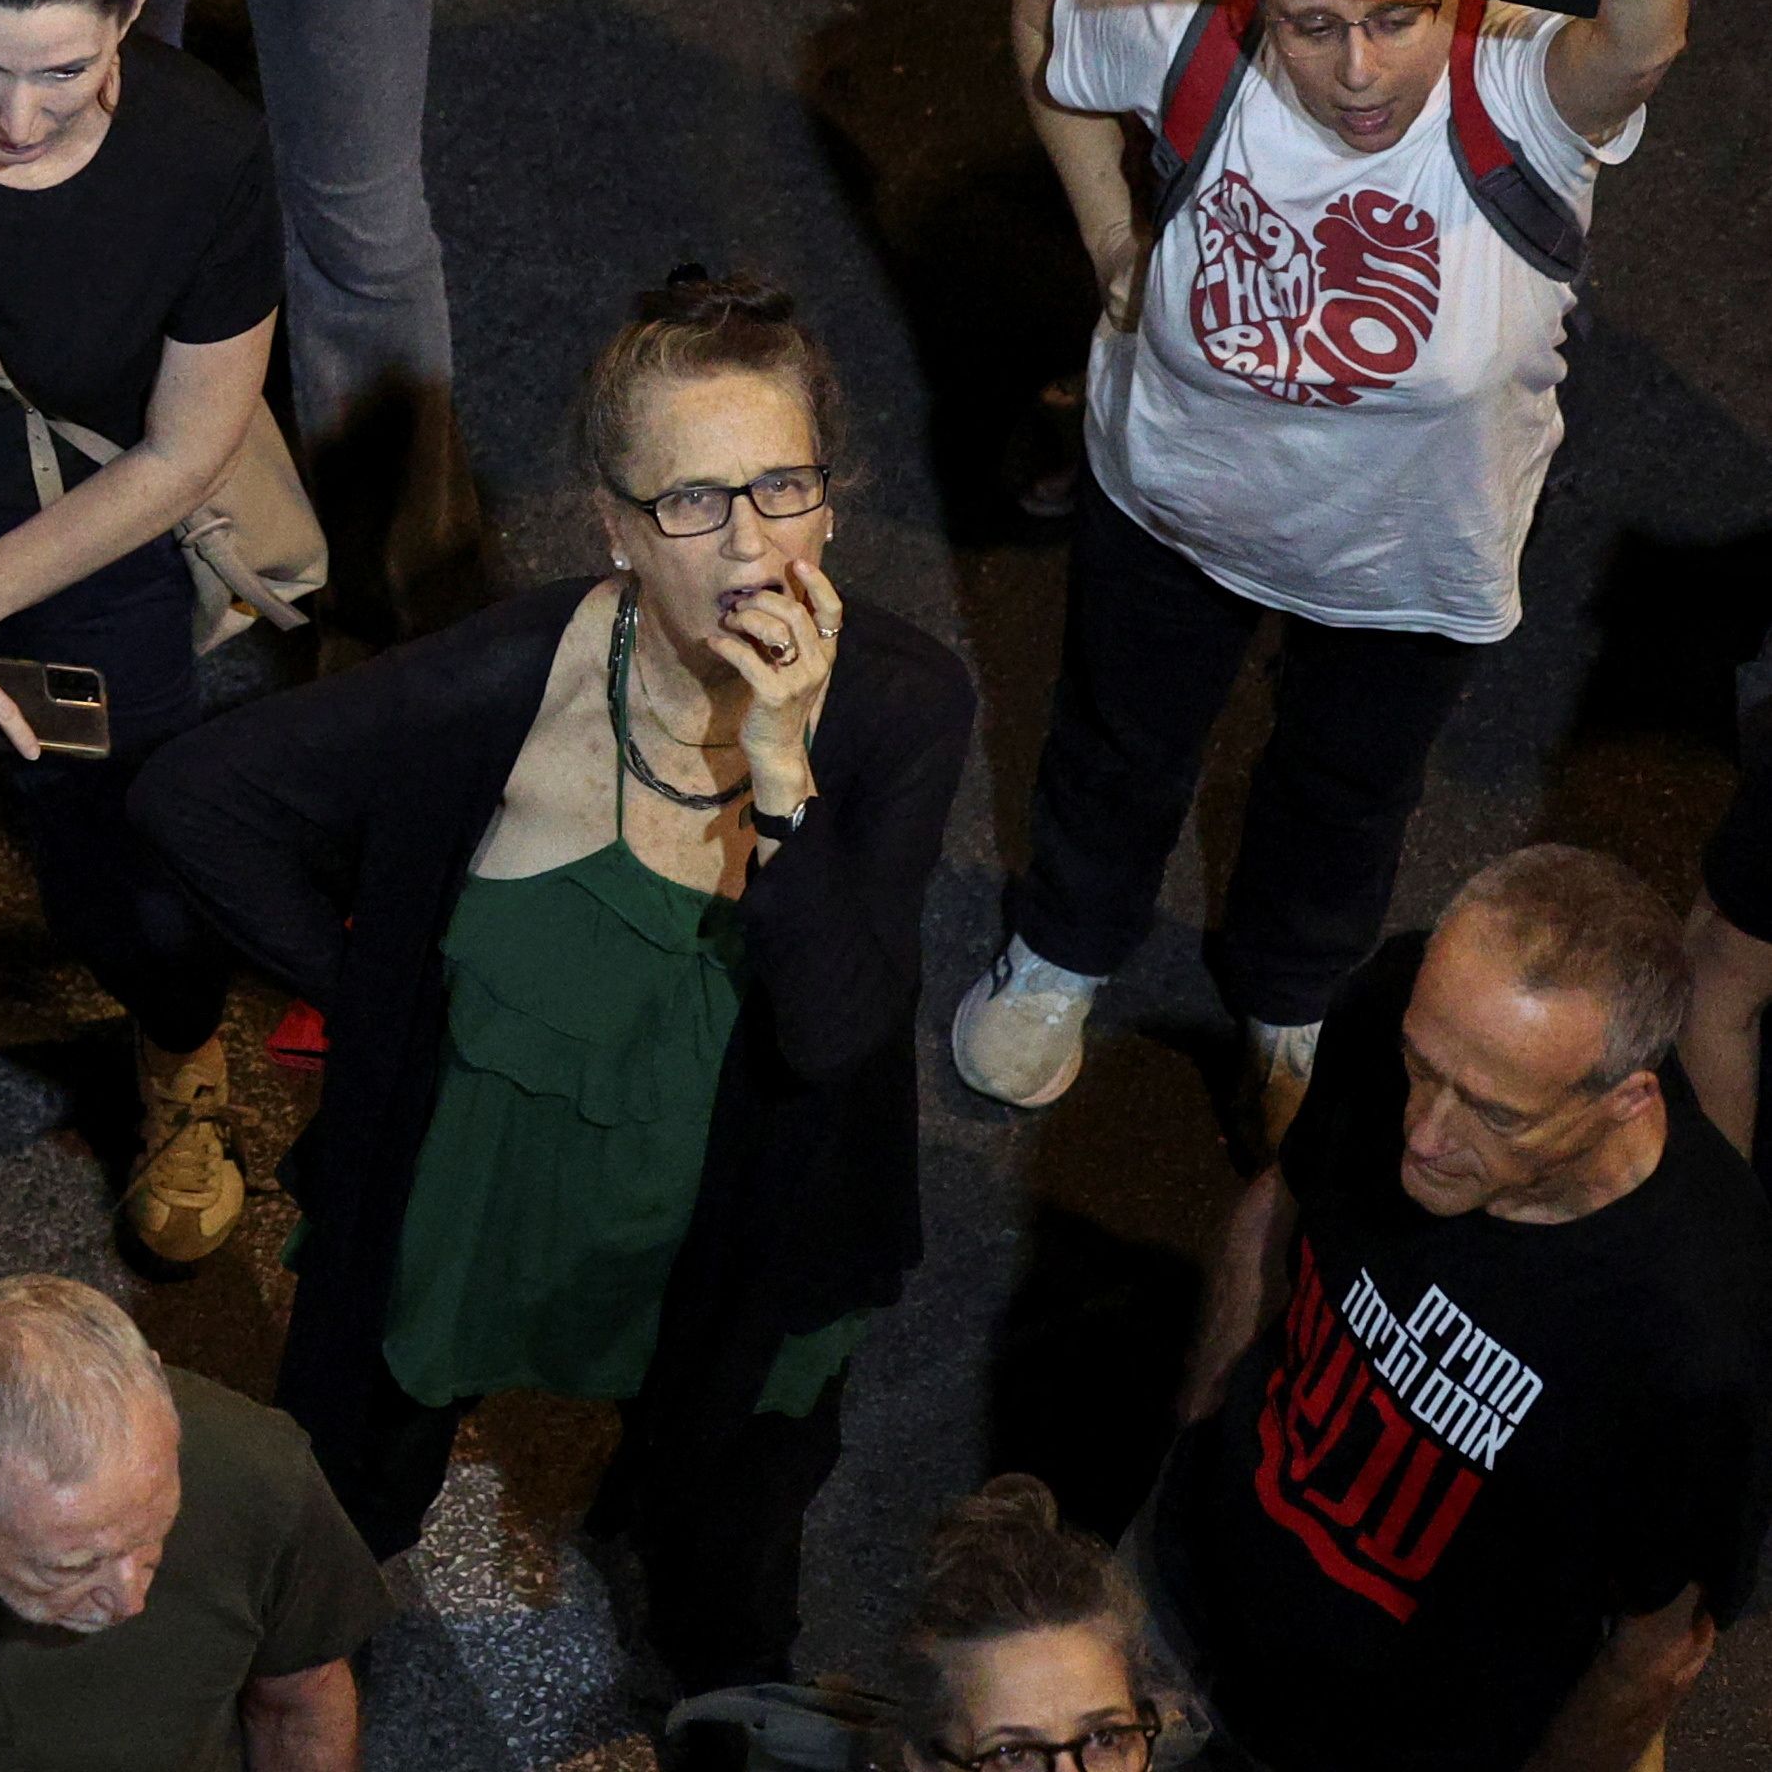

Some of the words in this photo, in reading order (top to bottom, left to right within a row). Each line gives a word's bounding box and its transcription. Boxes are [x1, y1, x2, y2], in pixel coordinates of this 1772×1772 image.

[1341, 1266, 1428, 1399] הביתה
[1405, 1283, 1544, 1425] מחזירים
[1410, 1367, 1515, 1472] אותם
